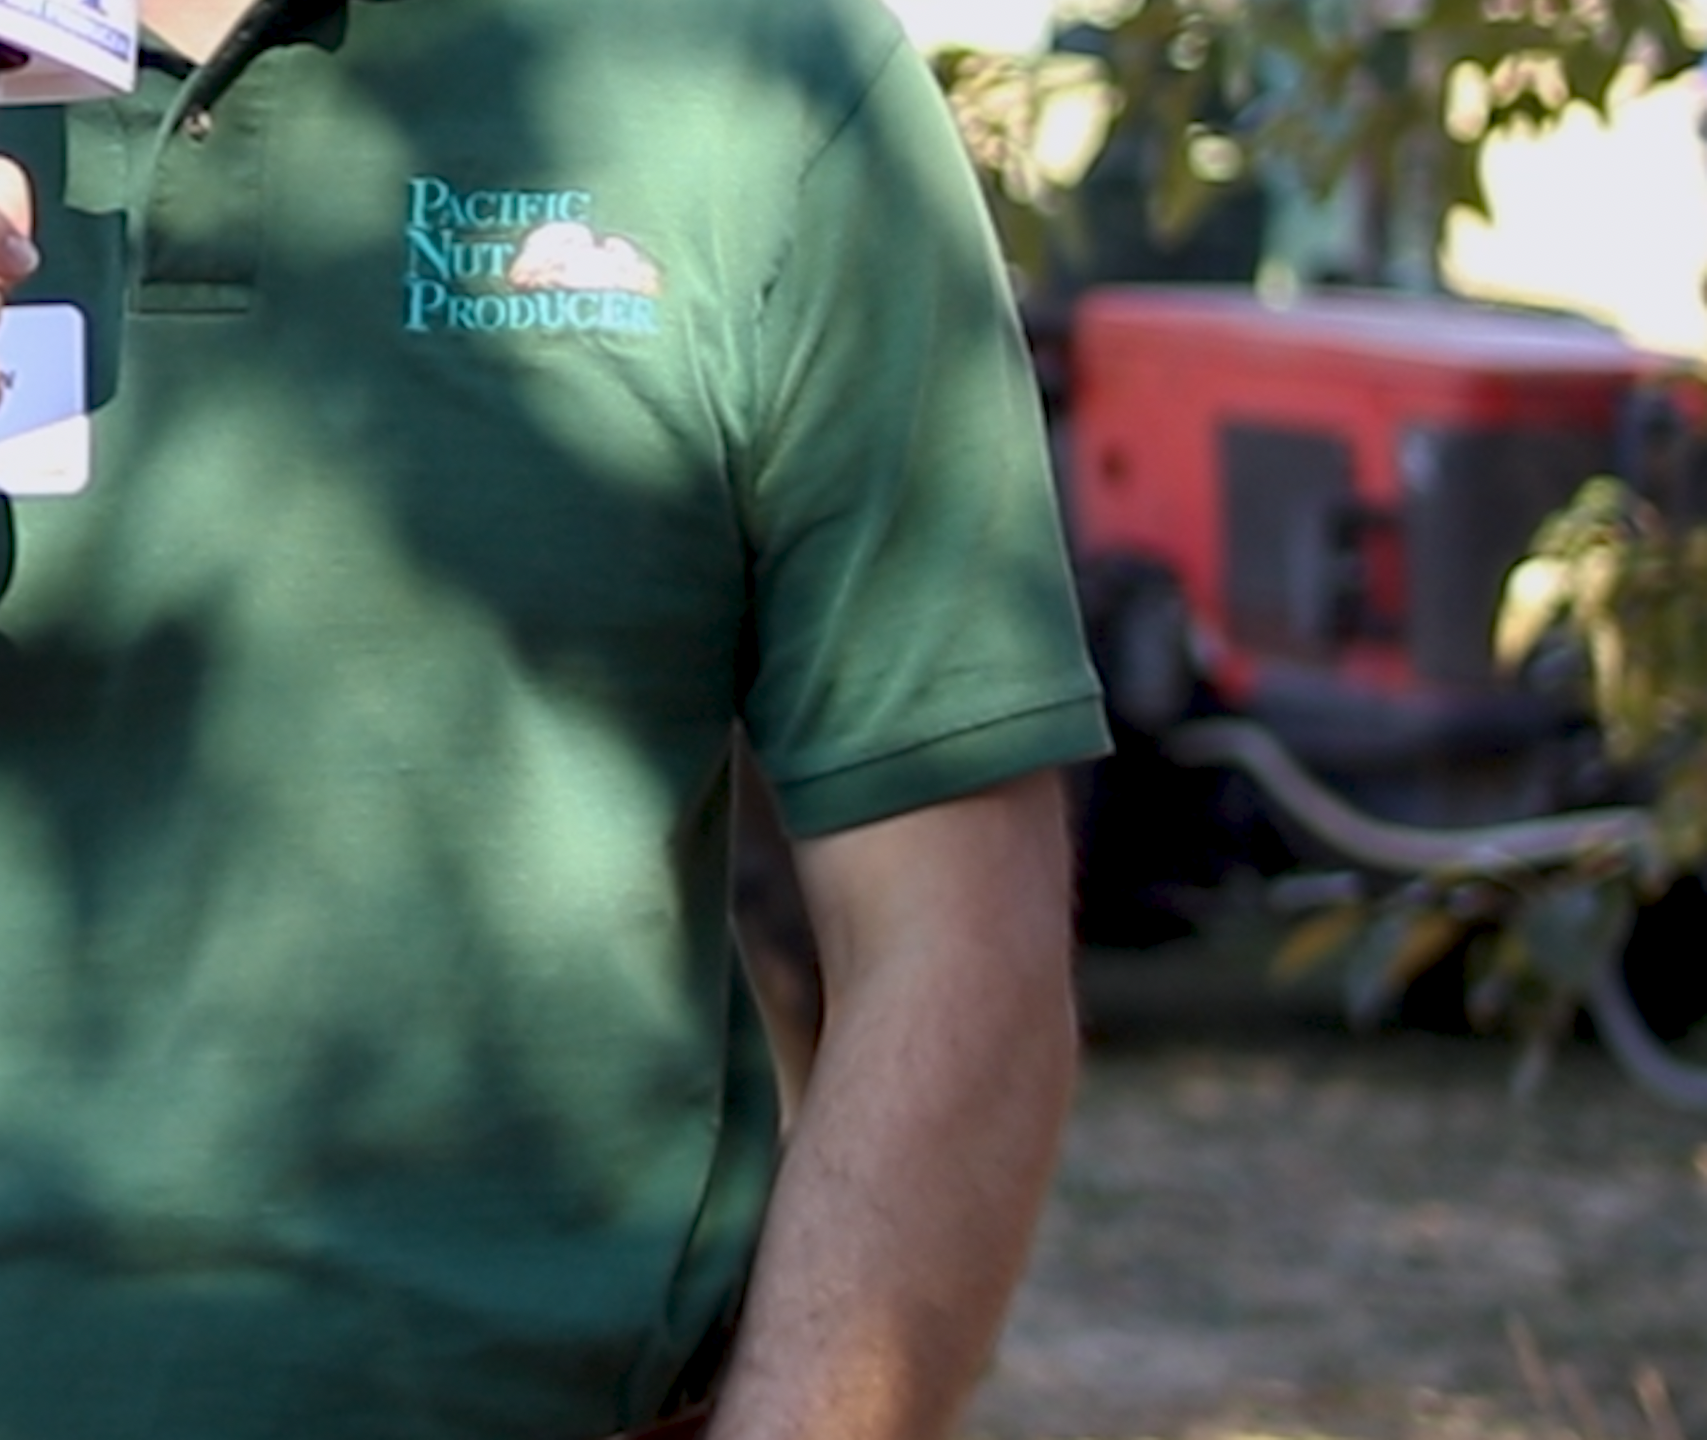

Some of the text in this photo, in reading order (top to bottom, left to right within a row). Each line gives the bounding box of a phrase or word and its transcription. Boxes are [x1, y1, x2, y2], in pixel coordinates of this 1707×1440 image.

[407, 176, 591, 231] PACIFIC
[406, 227, 515, 280] NUT
[403, 278, 661, 333] PRODUCER
